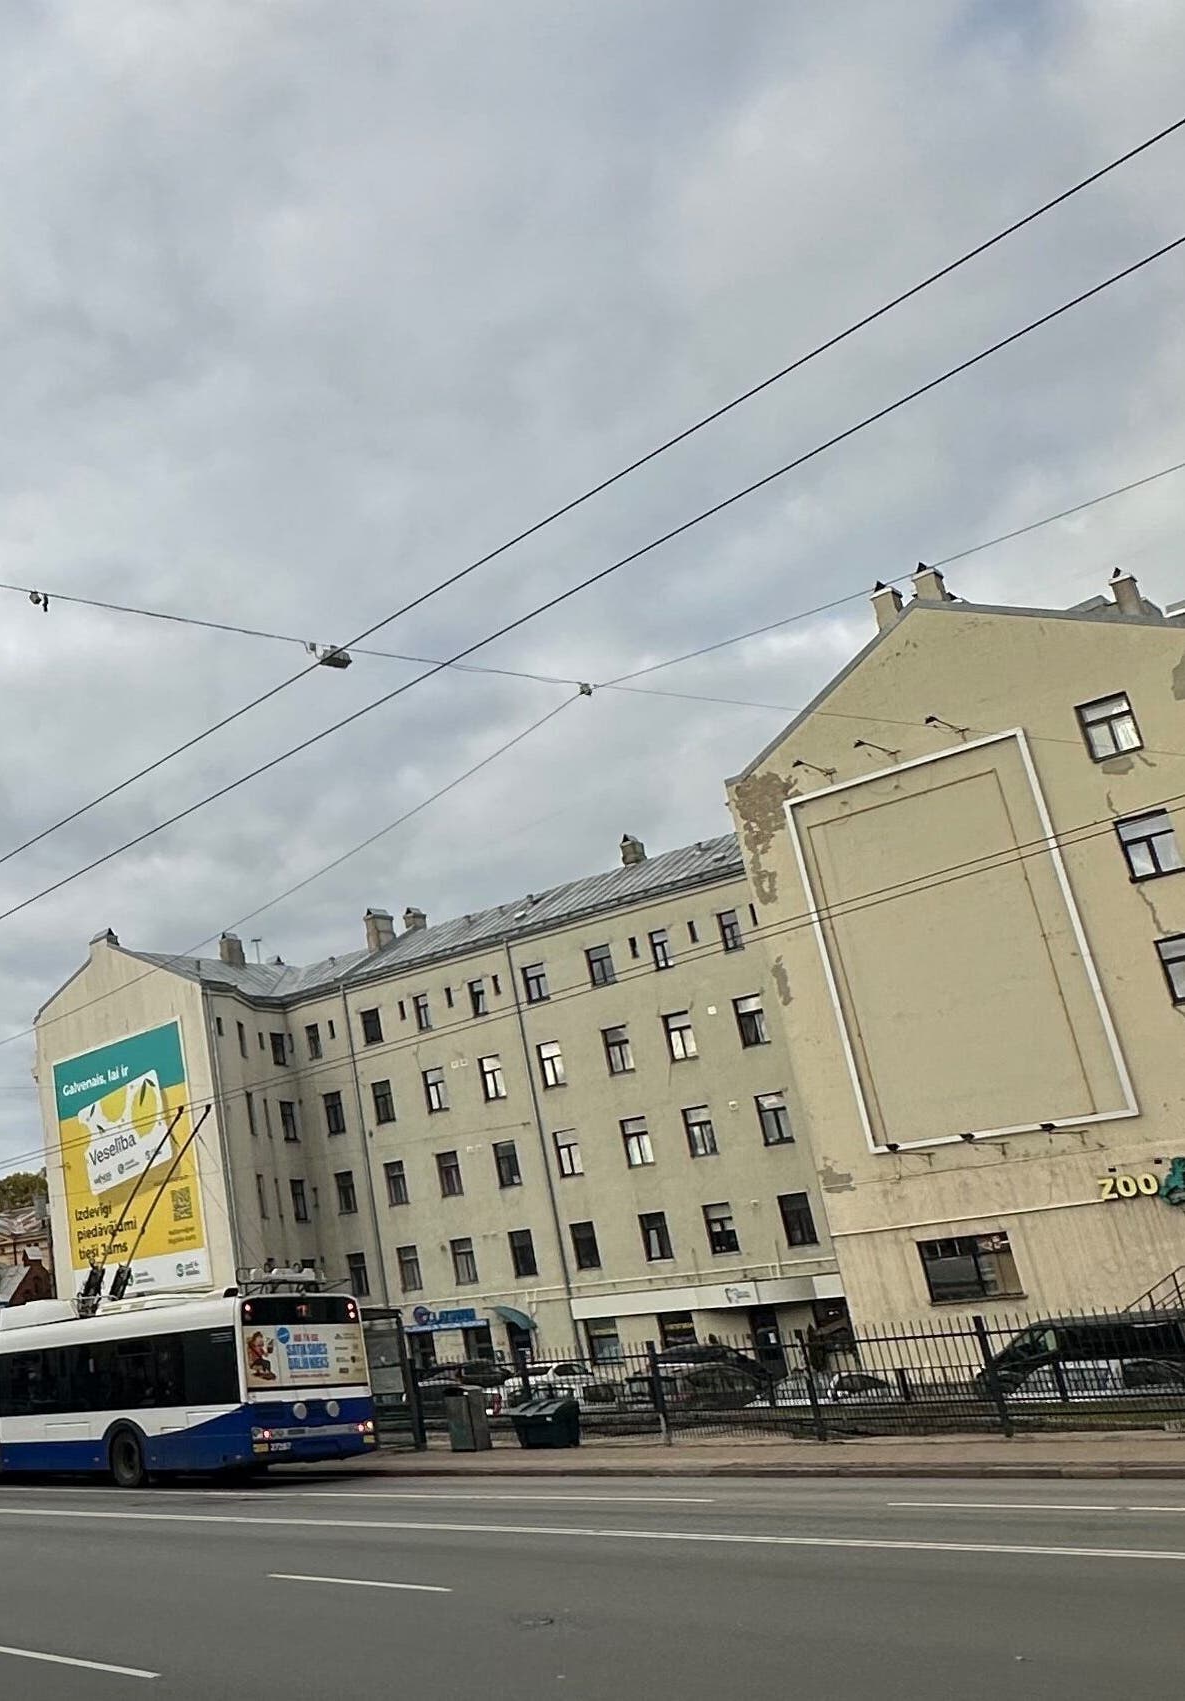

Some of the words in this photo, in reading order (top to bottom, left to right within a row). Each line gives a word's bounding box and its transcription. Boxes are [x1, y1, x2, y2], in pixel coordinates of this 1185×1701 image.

[108, 1066, 119, 1081] lai
[121, 1064, 128, 1077] ir
[89, 1134, 137, 1166] Veselība
[75, 1201, 112, 1220] Izdevīgi
